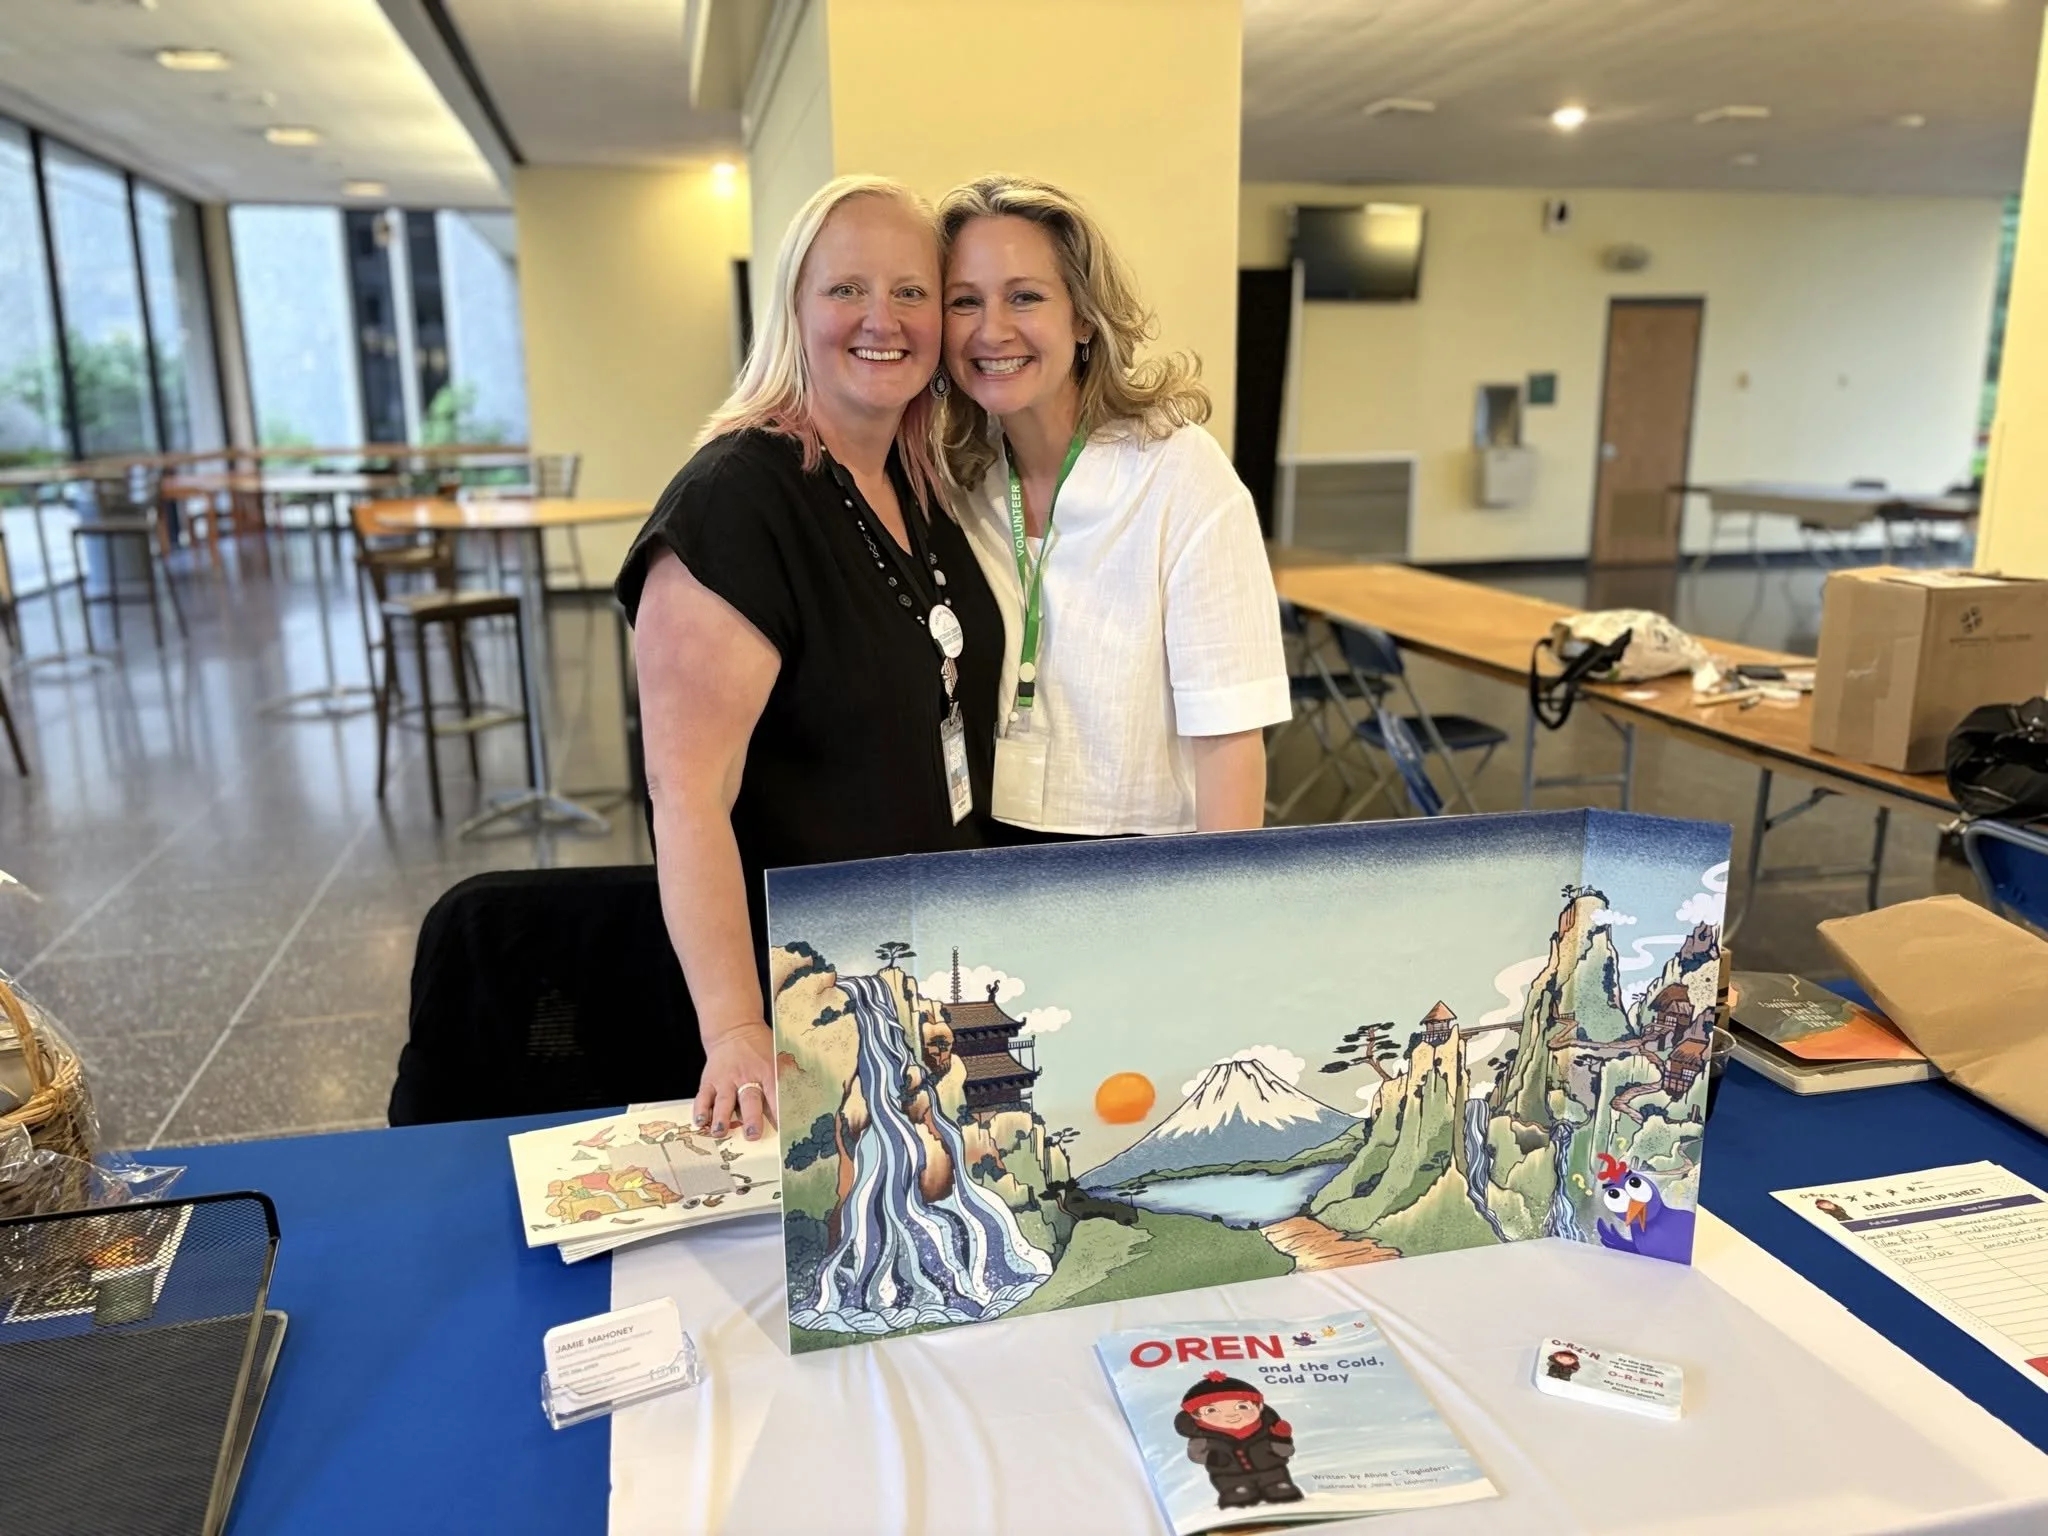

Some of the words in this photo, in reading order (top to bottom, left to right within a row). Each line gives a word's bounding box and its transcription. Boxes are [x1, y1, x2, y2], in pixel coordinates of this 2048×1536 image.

[1011, 484, 1025, 557] VOLUNTEER
[1862, 1201, 1902, 1211] EMAIL
[1901, 1197, 1932, 1205] SIGN
[1948, 1187, 1985, 1198] SHEET
[555, 1340, 584, 1354] JAMIE
[587, 1326, 635, 1345] MAHONEY
[1129, 1335, 1285, 1369] OREN
[1258, 1361, 1292, 1374] and
[1299, 1359, 1330, 1373] the
[1337, 1356, 1385, 1371] Cold,
[1264, 1373, 1305, 1386] Cold
[1314, 1371, 1350, 1387] Day
